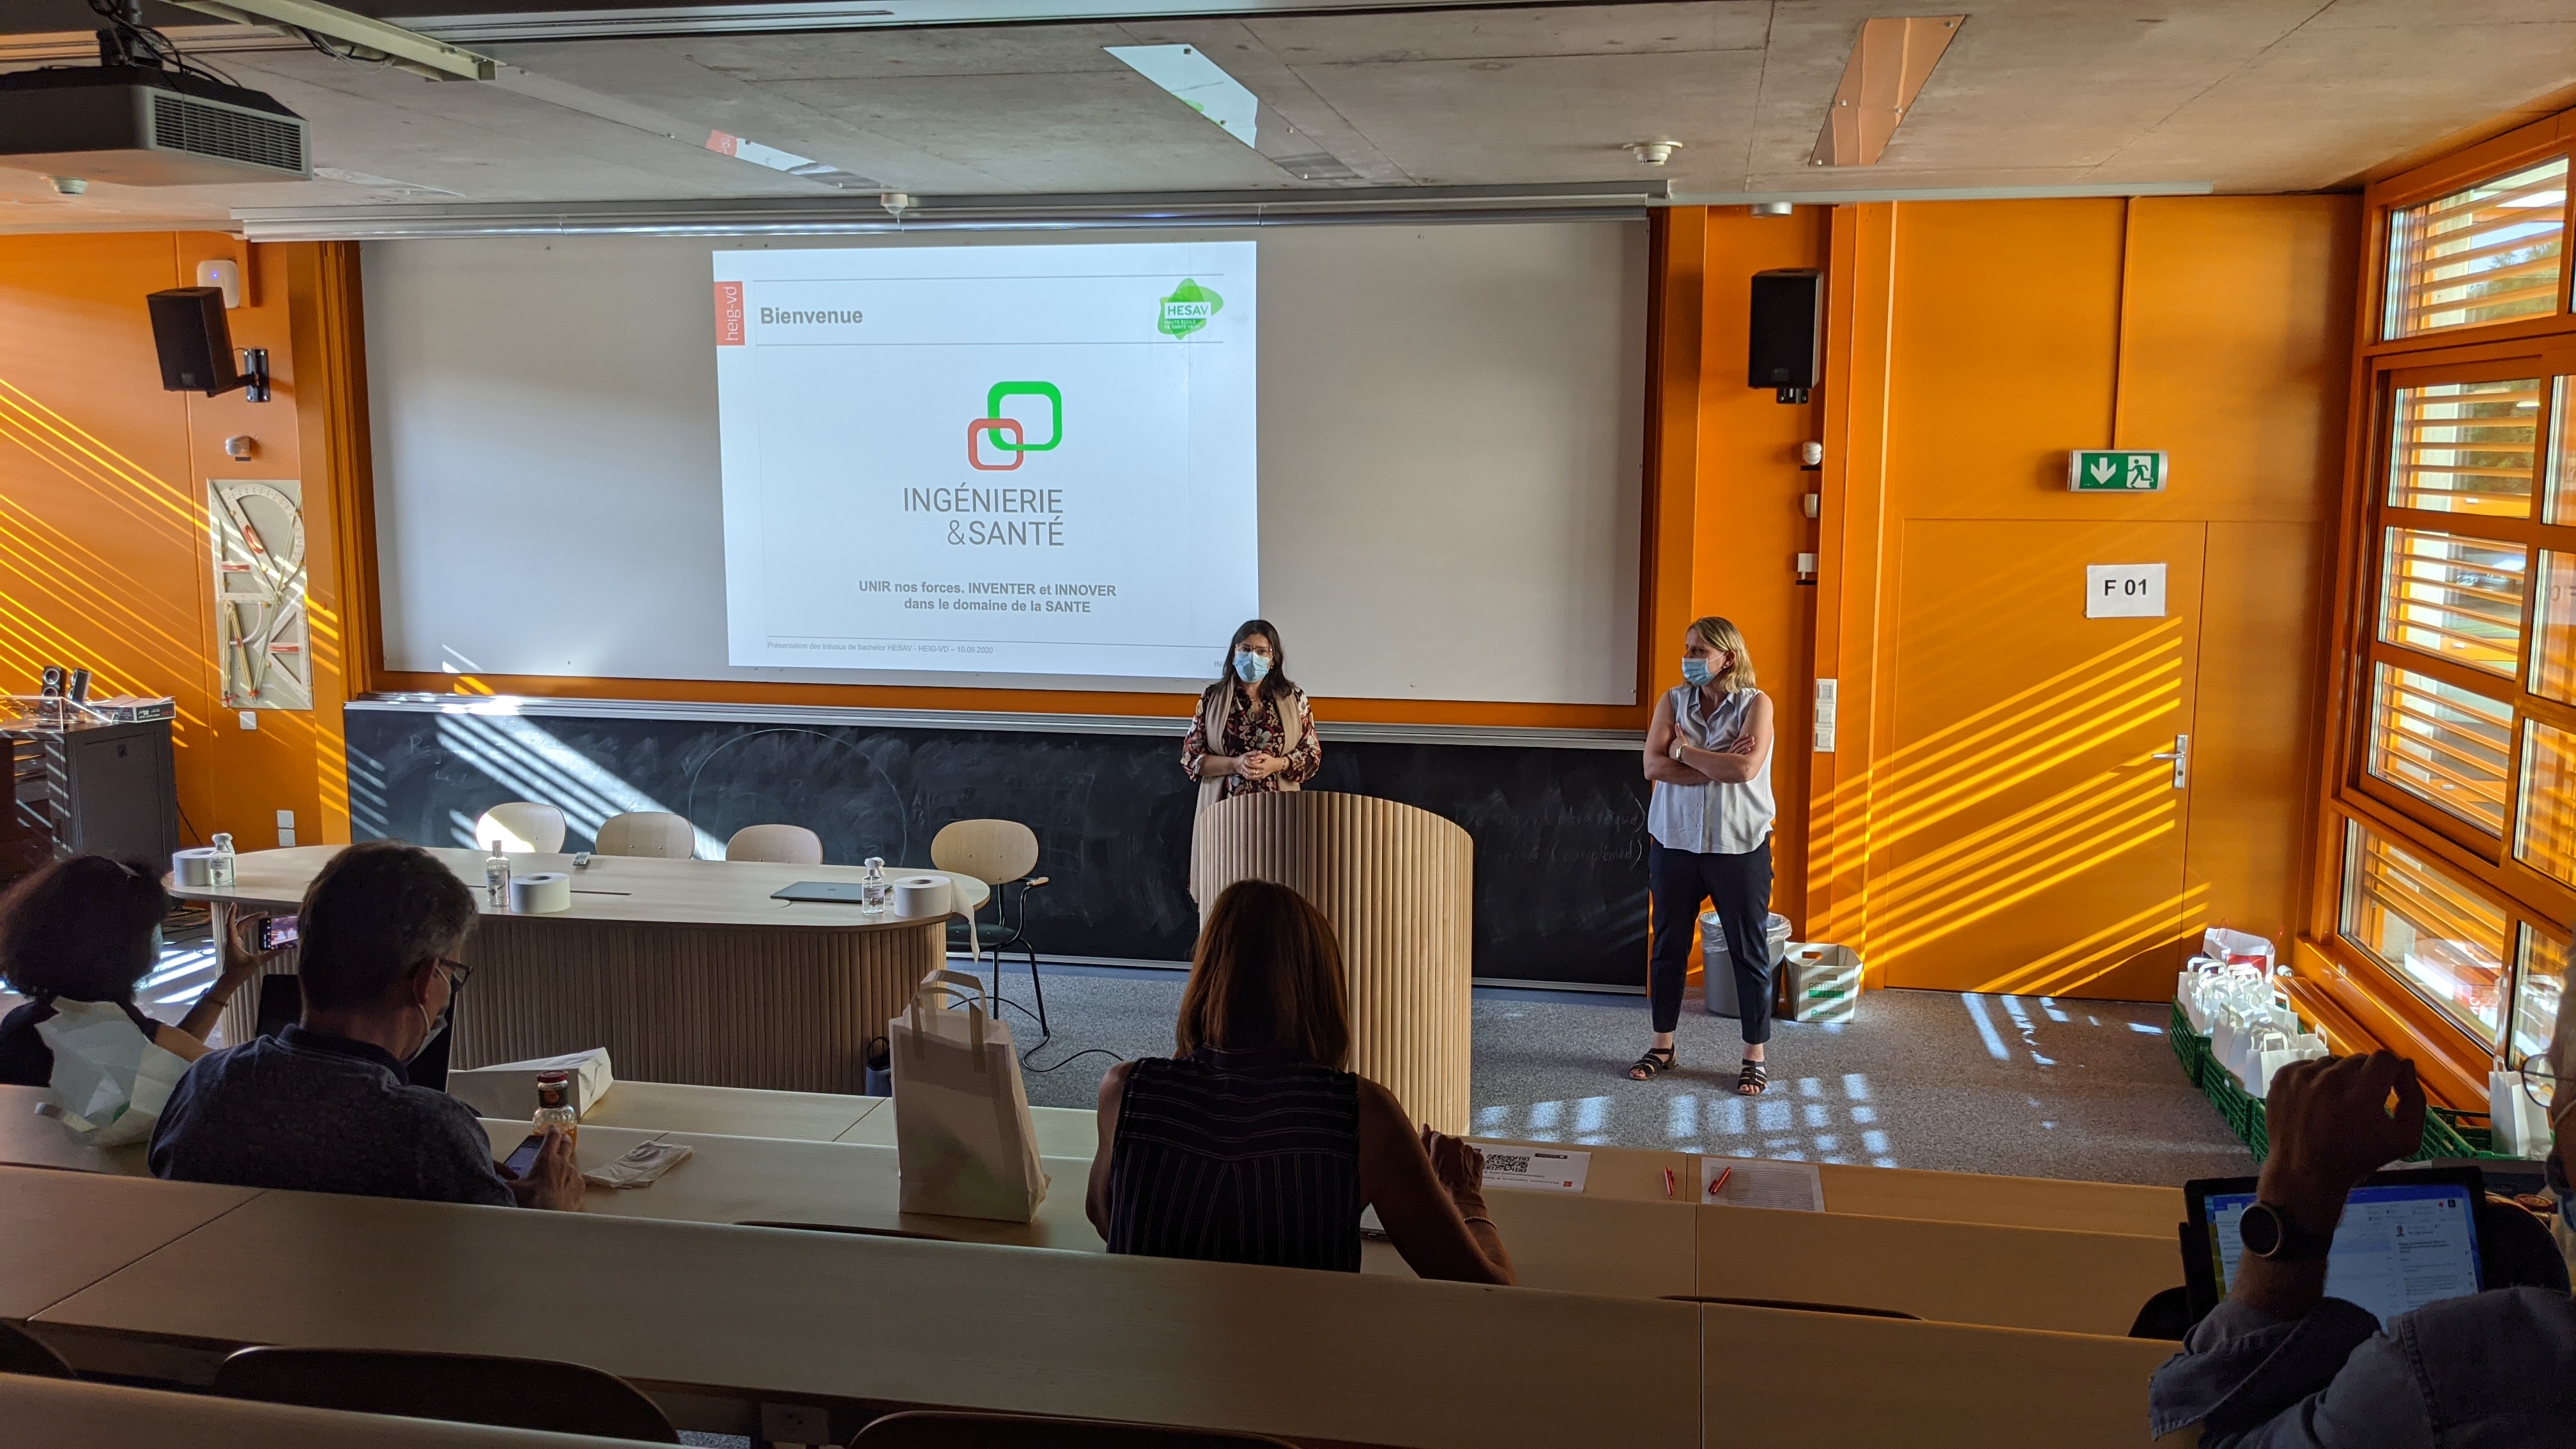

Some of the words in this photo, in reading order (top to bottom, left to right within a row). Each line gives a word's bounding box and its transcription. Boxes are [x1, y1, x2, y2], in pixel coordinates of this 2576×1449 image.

[723, 286, 740, 341] heig-vd
[760, 307, 862, 325] Bienvenue
[1167, 305, 1208, 316] HESAV
[904, 482, 1063, 514] INGÉNIERIE
[947, 516, 1064, 546] &SANTÉ
[859, 581, 891, 592] UNIR
[895, 583, 917, 593] nos
[921, 582, 965, 594] forces.
[969, 582, 1036, 595] INVENTER
[1039, 585, 1052, 595] et
[1055, 584, 1116, 597] INNOVER
[2104, 579, 2117, 596] F
[2124, 579, 2147, 596] 01
[904, 598, 935, 609] dans
[939, 599, 949, 610] le
[953, 599, 1008, 611] domaine
[1011, 600, 1027, 611] de
[1031, 601, 1041, 611] la
[1045, 601, 1091, 612] SANTE
